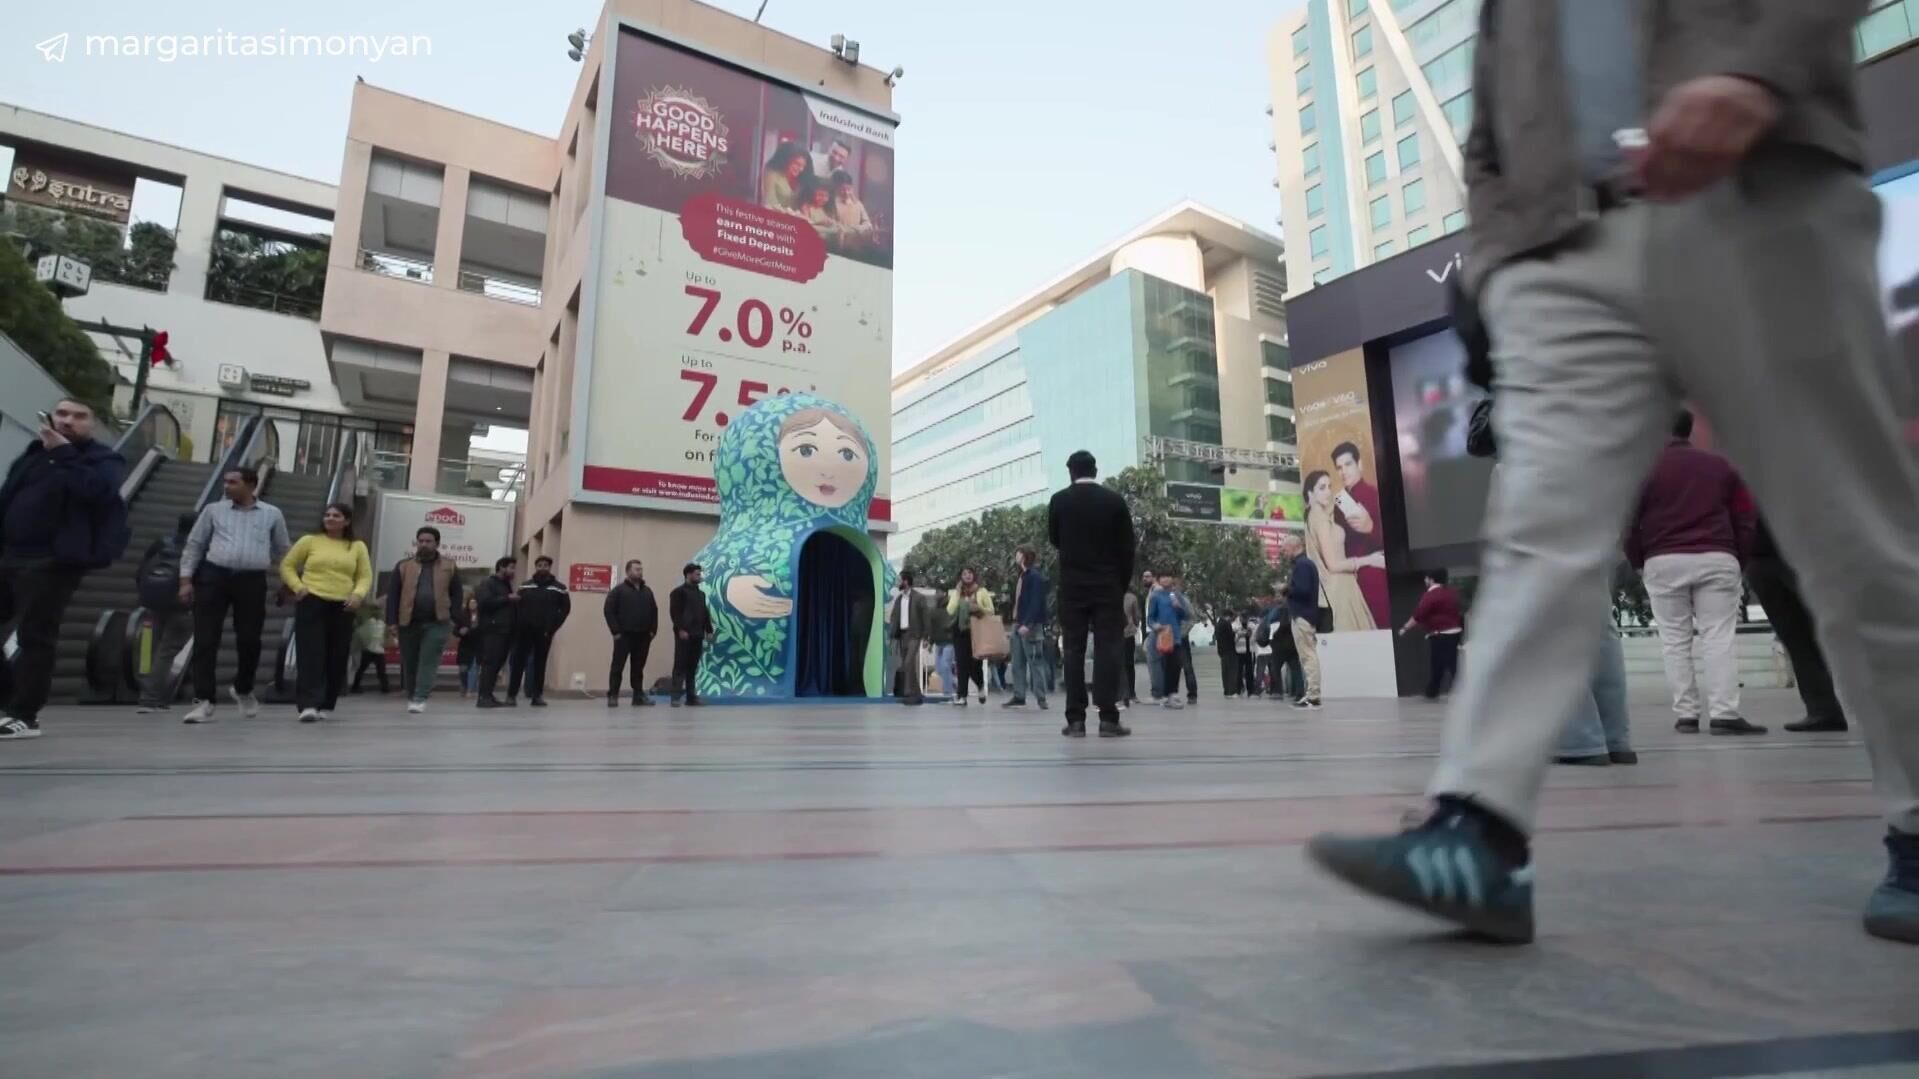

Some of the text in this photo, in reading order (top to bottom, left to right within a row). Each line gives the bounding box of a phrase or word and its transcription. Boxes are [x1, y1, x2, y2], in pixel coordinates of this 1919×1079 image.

[653, 102, 714, 131] GOOD
[819, 111, 890, 141] IndusInd Bank
[636, 113, 728, 152] HAPPENS
[657, 132, 707, 160] HERE
[716, 203, 798, 234] This festive season,
[716, 217, 796, 244] earn more with
[717, 229, 794, 256] Fixed Deposits
[713, 246, 797, 274] #GiveMoreGetMore
[1427, 252, 1462, 284] vi
[686, 271, 716, 285] Up to
[782, 339, 811, 354] p.a.
[681, 354, 713, 368] Up to
[1299, 361, 1328, 375] vivo
[695, 429, 715, 442] For
[685, 451, 704, 461] on
